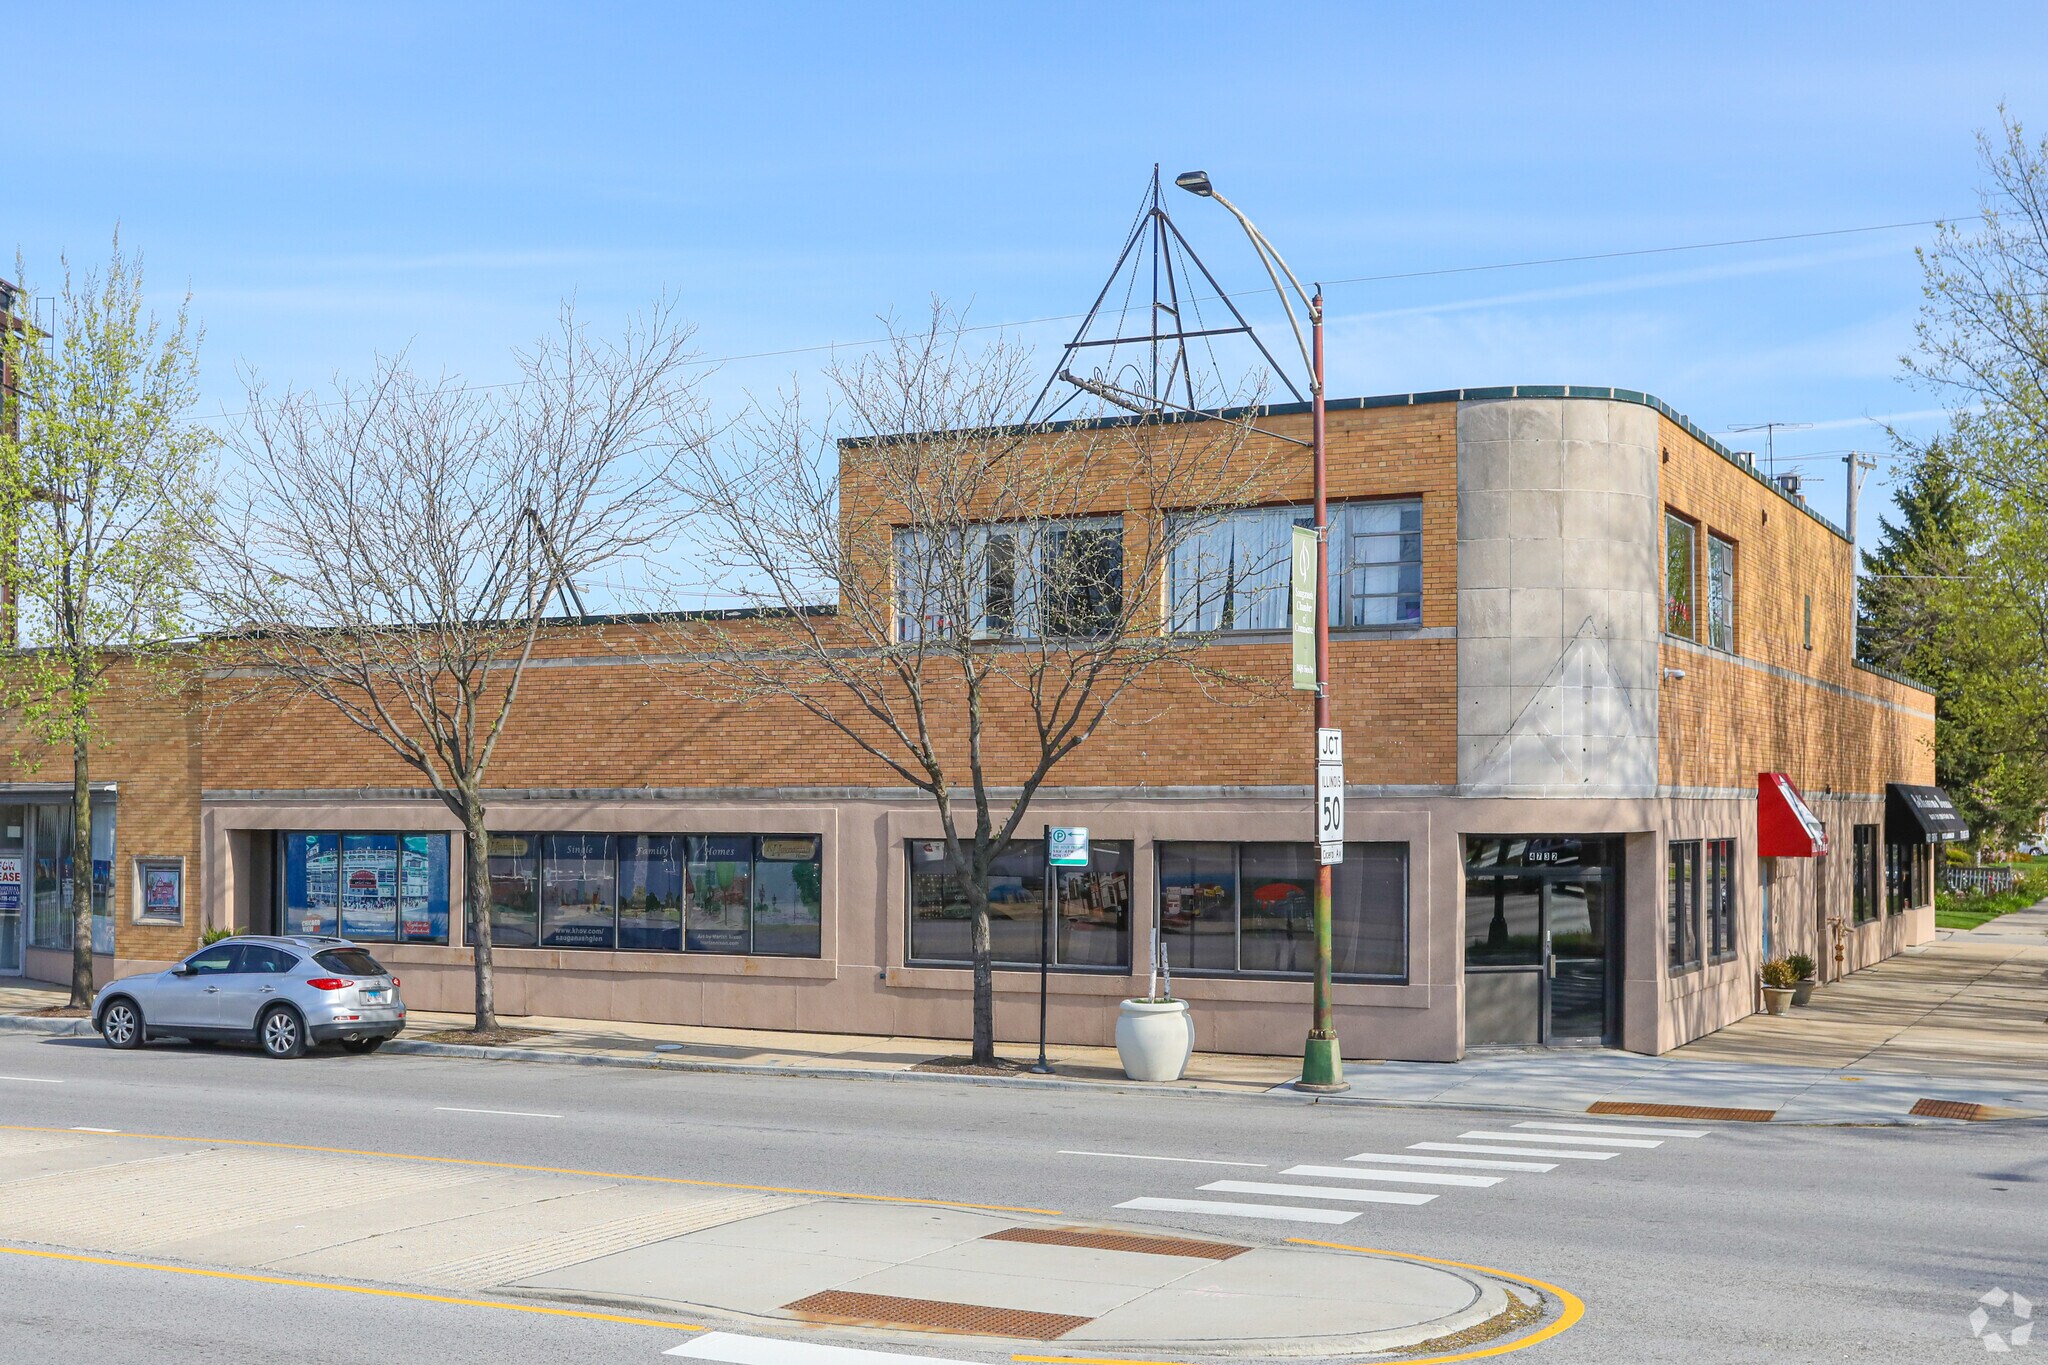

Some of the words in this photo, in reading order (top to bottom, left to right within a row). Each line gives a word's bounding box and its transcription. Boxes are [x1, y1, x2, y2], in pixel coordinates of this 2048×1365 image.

[1322, 736, 1339, 755] JCT
[1322, 776, 1341, 788] ILLINOIS
[1323, 796, 1341, 831] 50
[566, 845, 593, 856] Single
[635, 846, 669, 857] Family
[704, 846, 735, 856] Homes
[1322, 849, 1334, 860] Cicero
[1529, 852, 1558, 861] 4732
